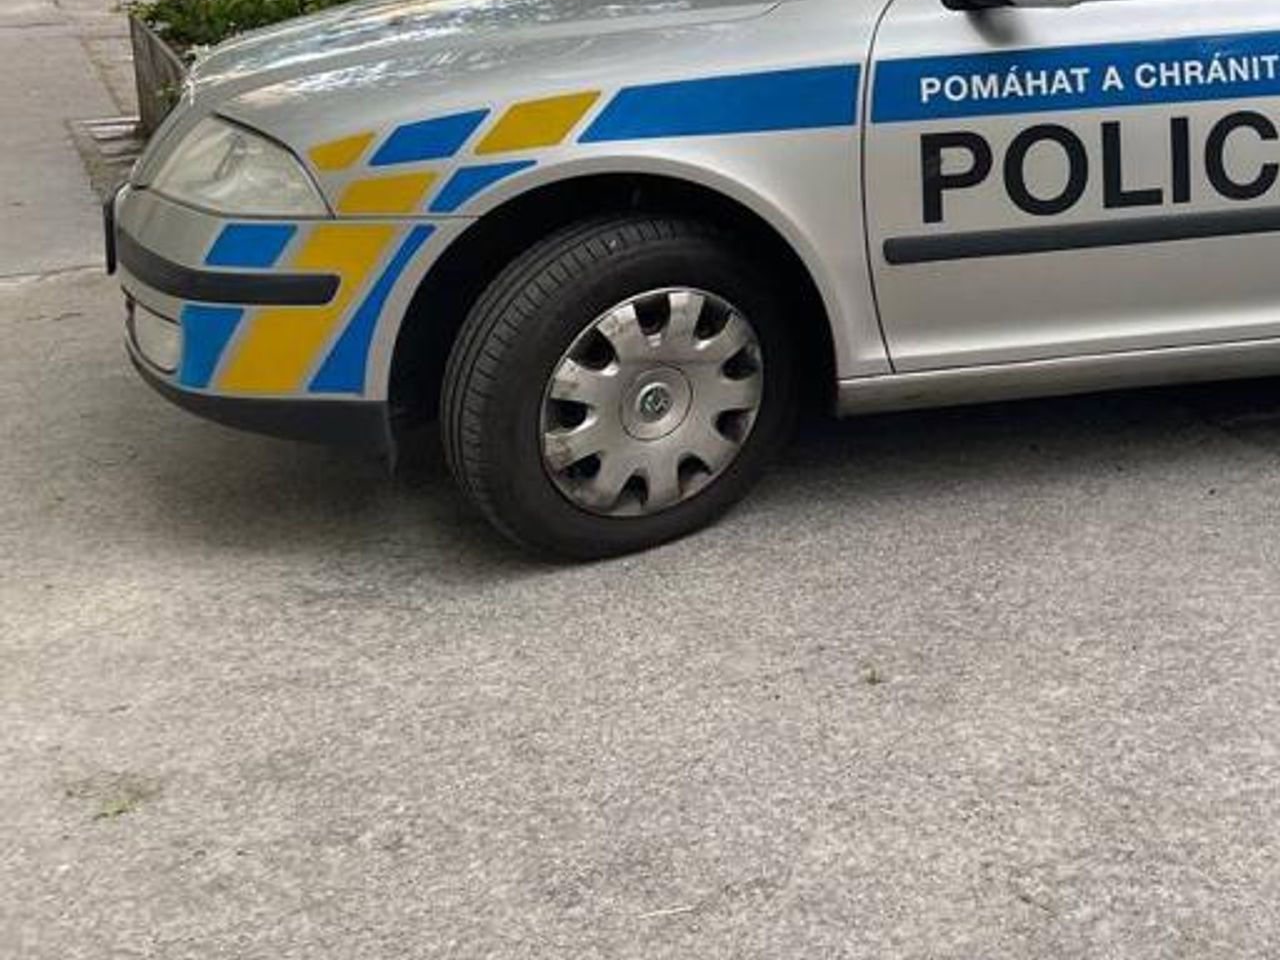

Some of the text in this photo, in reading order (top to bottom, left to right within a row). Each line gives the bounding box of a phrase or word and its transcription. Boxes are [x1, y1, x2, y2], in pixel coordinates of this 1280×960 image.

[920, 53, 1280, 104] POMÁHAT A CHRÁNIT
